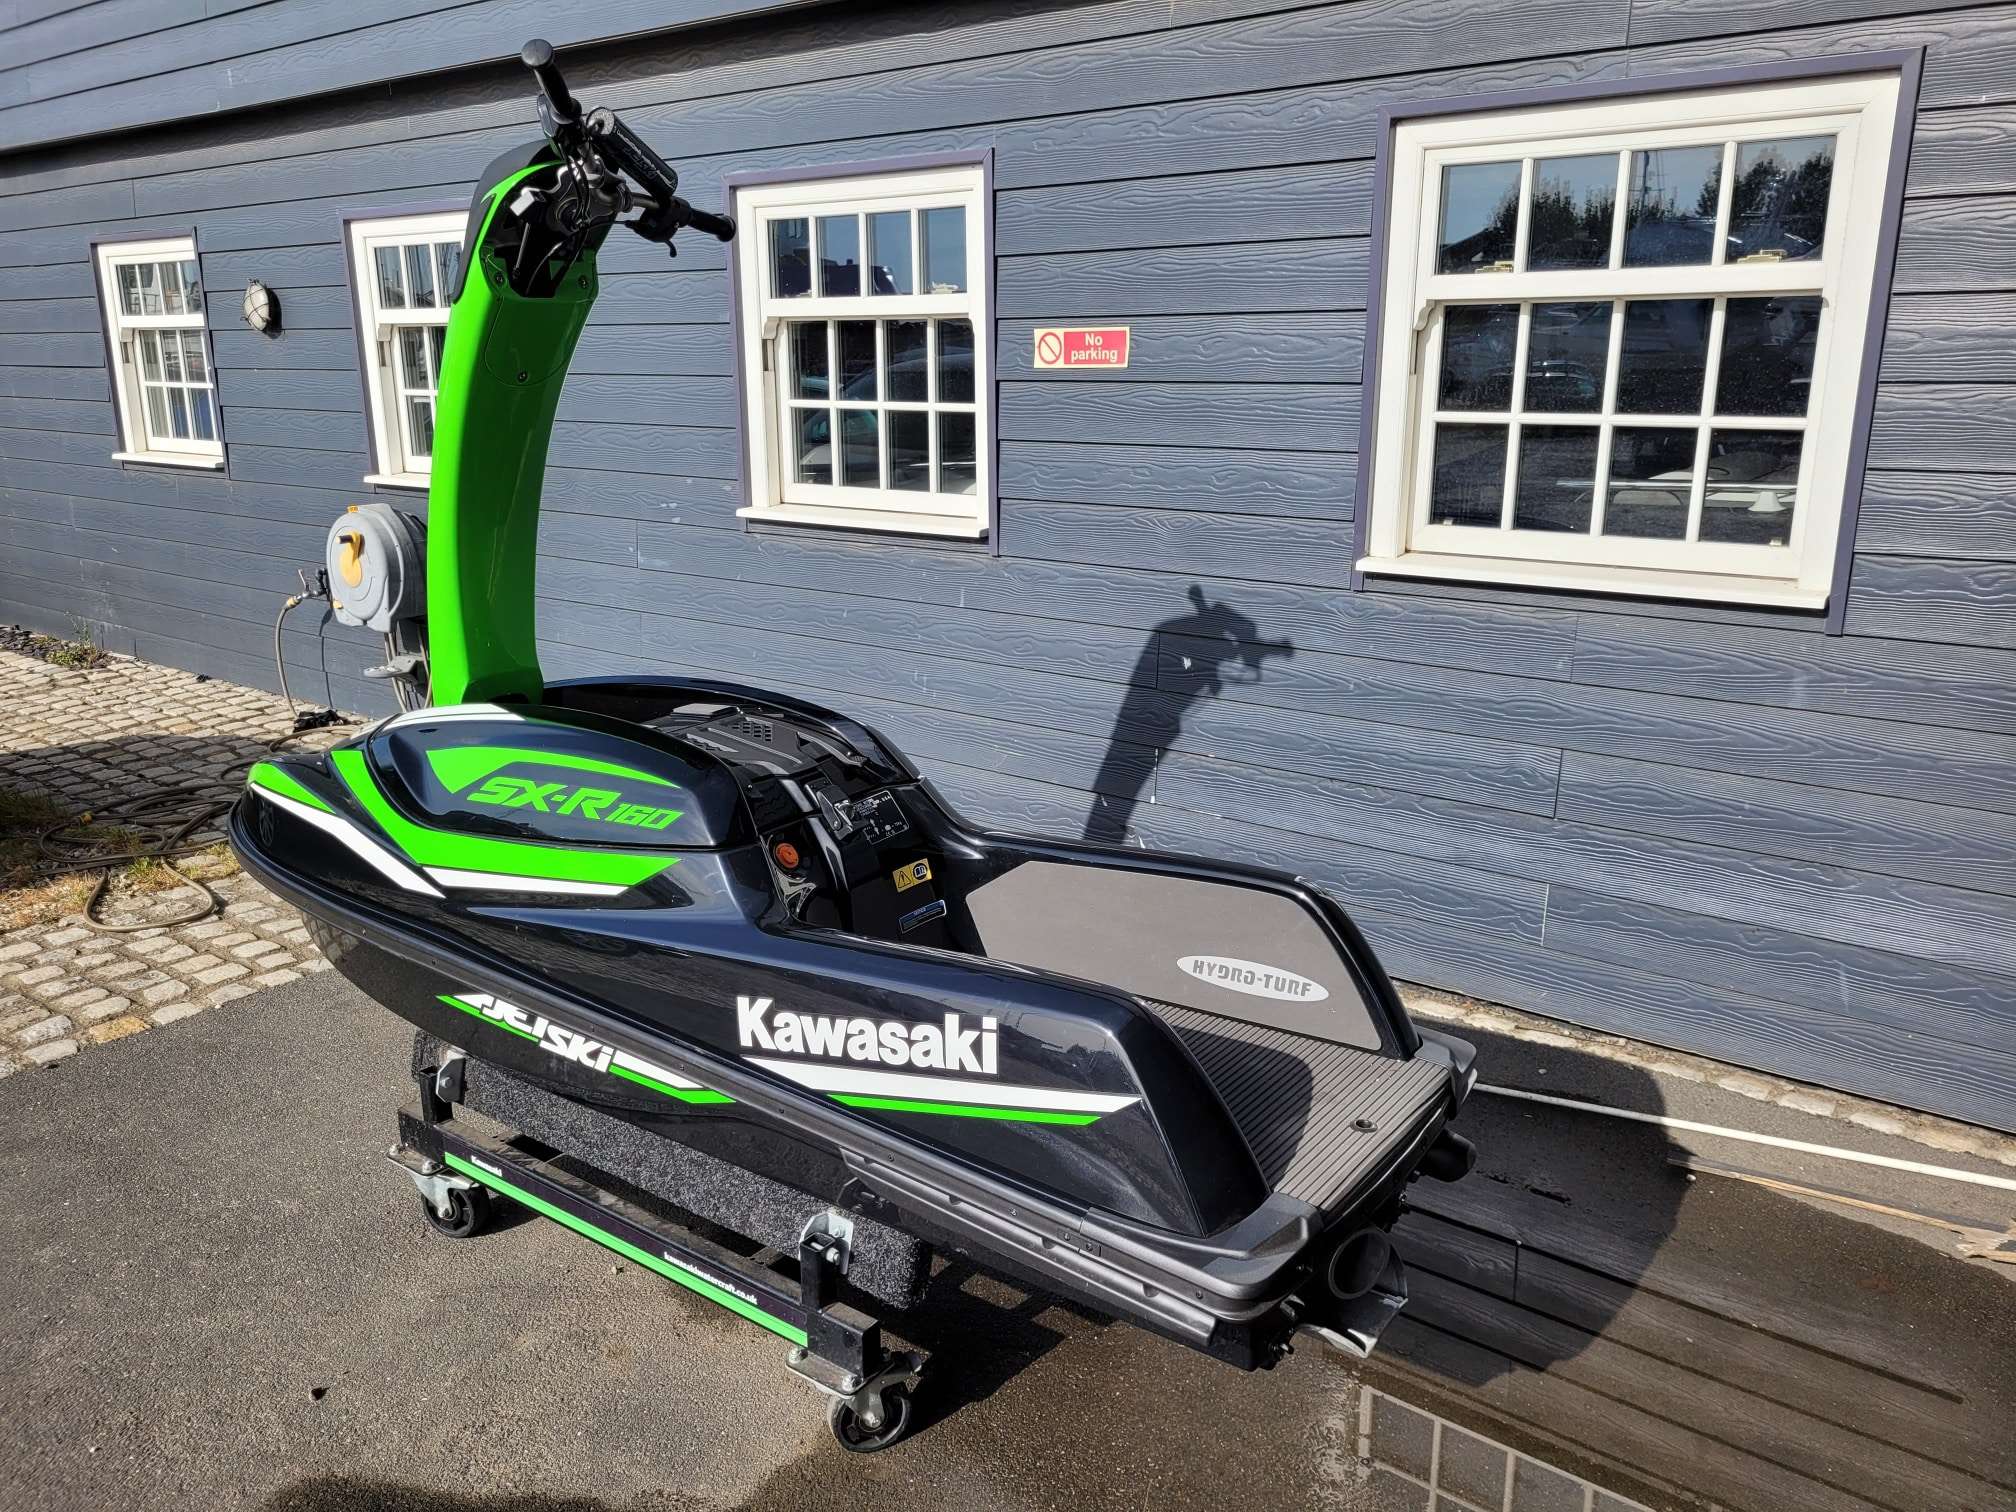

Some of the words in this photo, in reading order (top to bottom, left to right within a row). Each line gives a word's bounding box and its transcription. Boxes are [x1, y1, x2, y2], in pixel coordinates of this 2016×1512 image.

[1084, 333, 1103, 346] No
[1071, 347, 1118, 363] parking
[604, 803, 685, 830] 160
[1192, 959, 1312, 997] HYDRO-TURF
[737, 996, 998, 1074] Kawasaki
